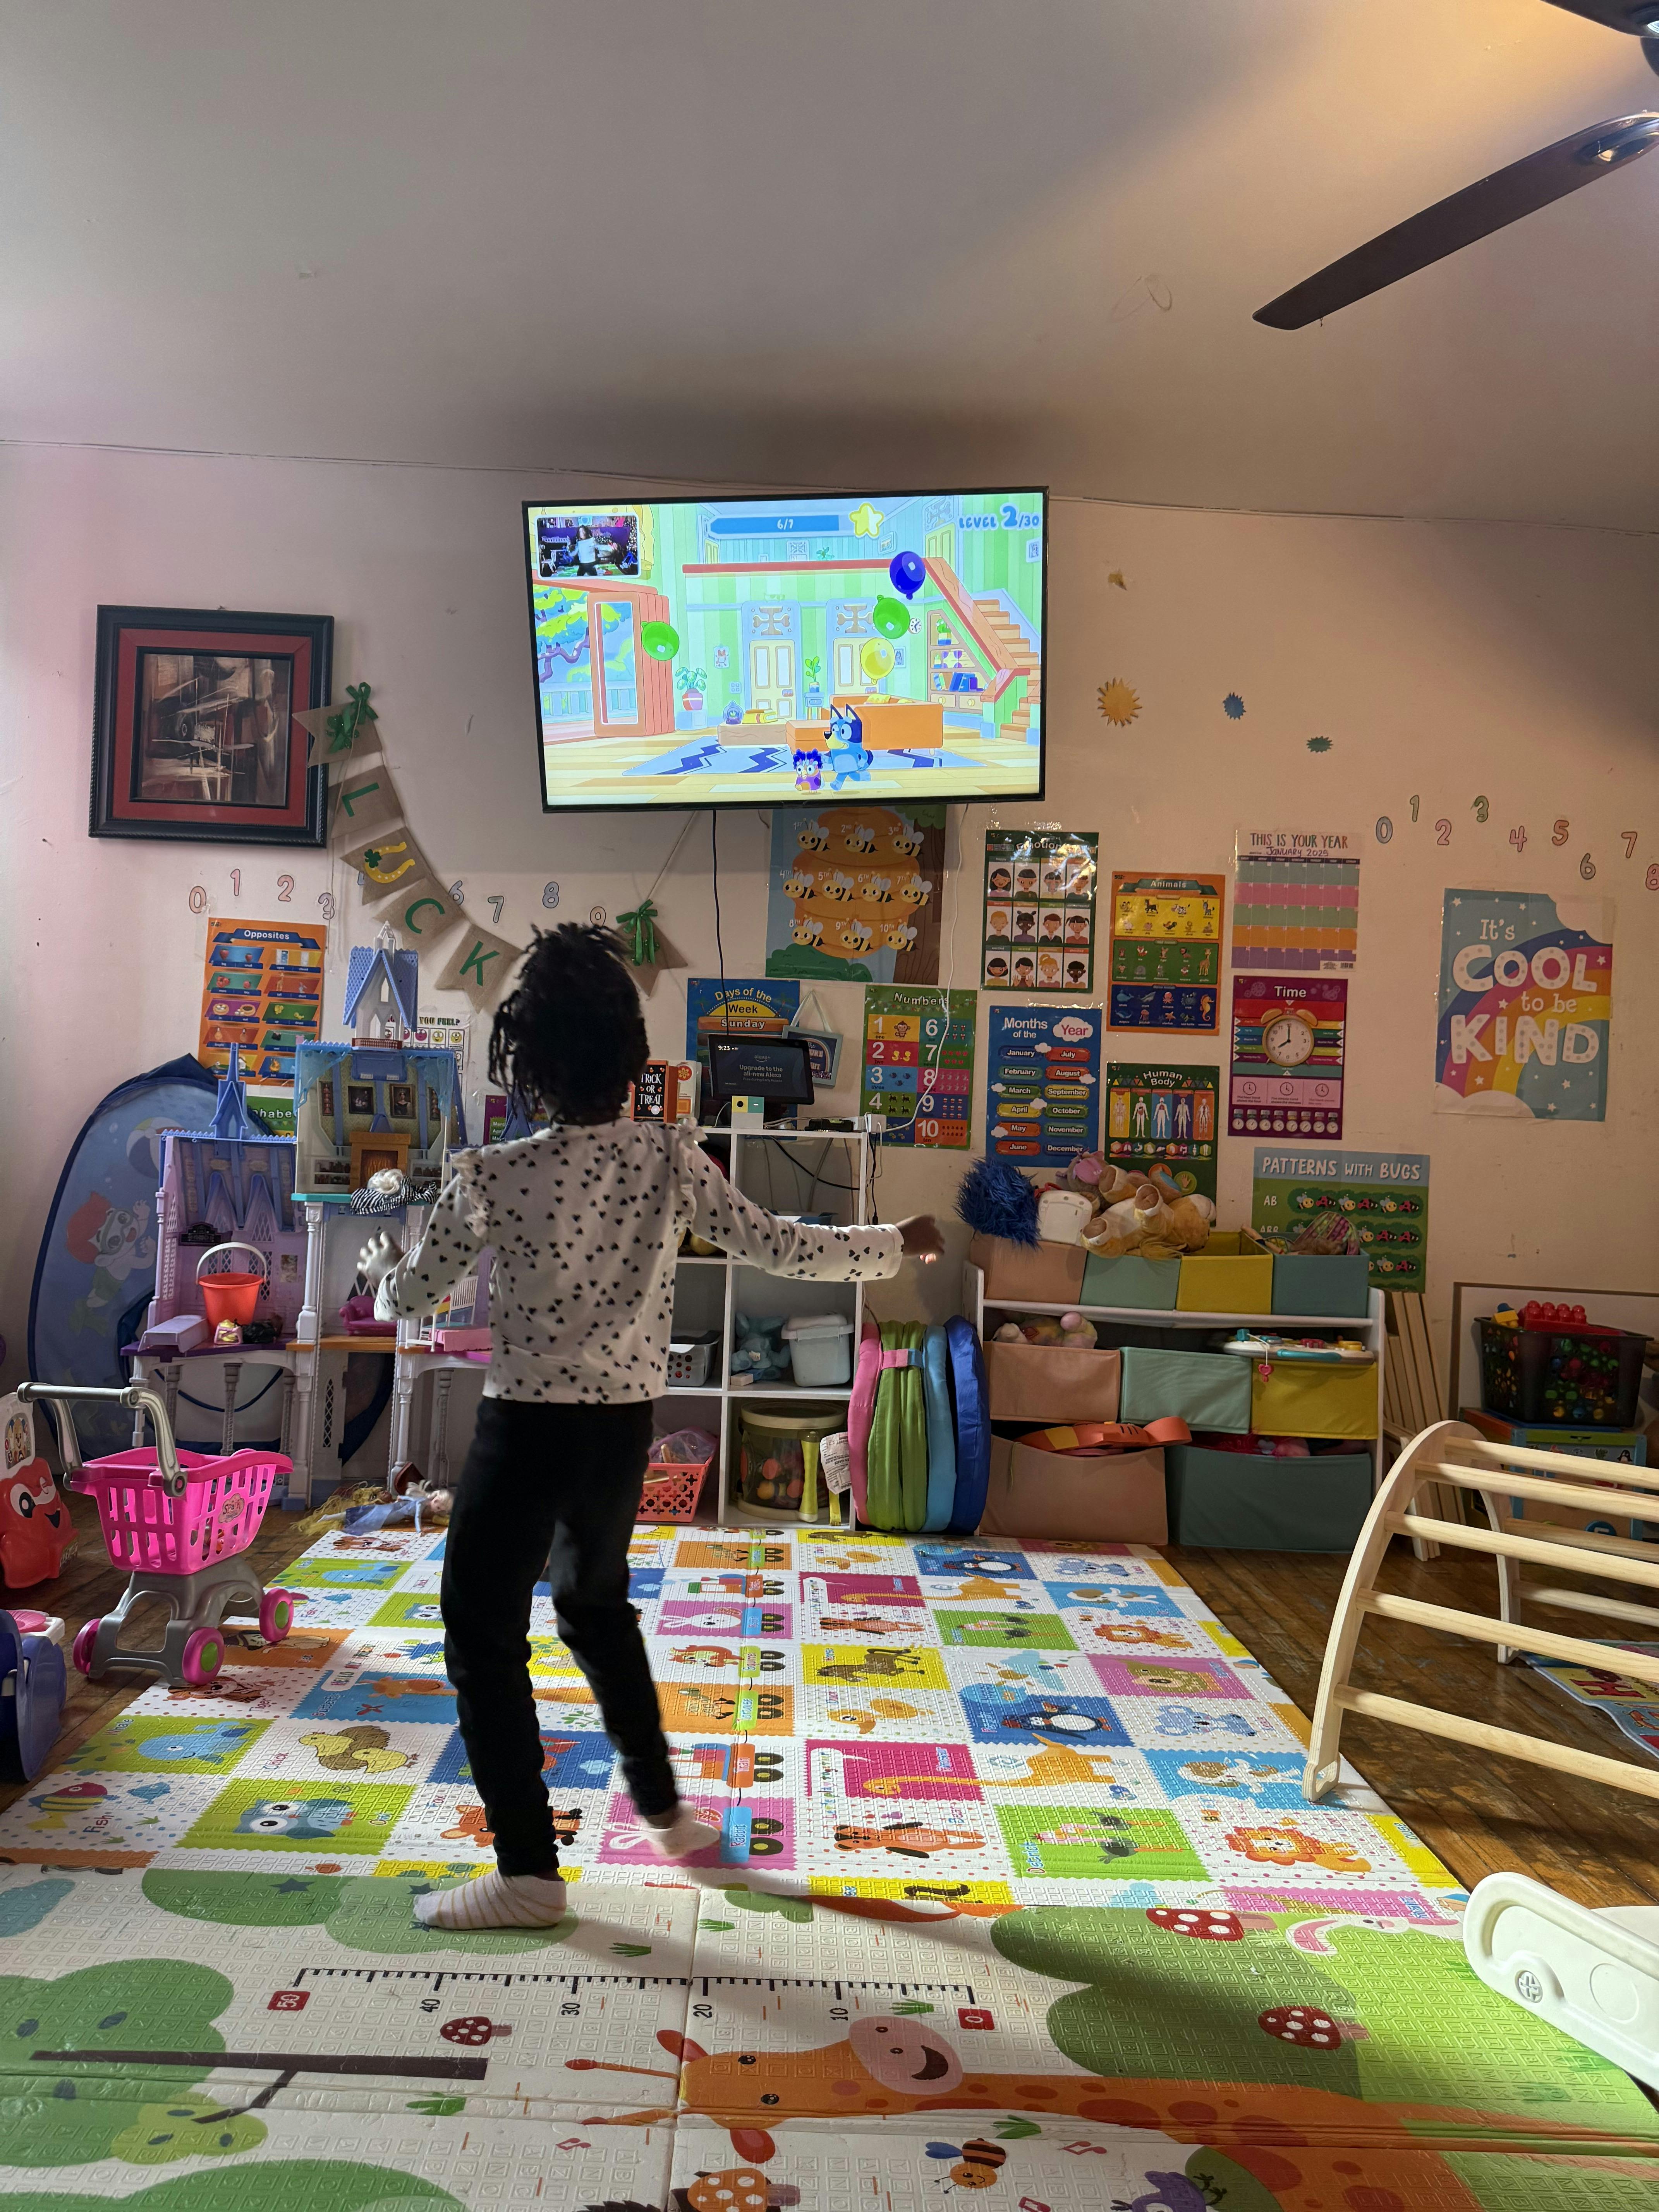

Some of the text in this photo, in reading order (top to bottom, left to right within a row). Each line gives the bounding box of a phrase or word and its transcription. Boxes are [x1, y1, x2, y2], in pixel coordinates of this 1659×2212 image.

[777, 520, 793, 530] 6/7
[958, 505, 1040, 529] LEVEL 2/30
[841, 825, 852, 833] 2ND
[889, 827, 899, 835] 3RD
[1250, 833, 1348, 848] THIS IS YOUR YEAR
[1376, 795, 1659, 890] 0 1 2 3 4 5 6 7 8
[858, 874, 869, 882] 6TH
[189, 886, 206, 914] 0
[230, 869, 240, 896] 1
[277, 875, 294, 902] 2
[318, 893, 335, 919] 3
[448, 880, 464, 905] 6
[488, 895, 504, 923] 7
[542, 881, 559, 908] 8
[789, 919, 894, 932] 8TH 9TH 10TH
[1480, 919, 1515, 940] It's
[244, 930, 290, 940] Opposites
[405, 898, 445, 934] C
[459, 941, 500, 986] K
[1453, 945, 1597, 992] COOL
[715, 988, 740, 1001] Days
[756, 989, 771, 1002] the
[894, 993, 950, 1006] Numbers
[1274, 986, 1307, 998] Time
[728, 1004, 758, 1014] Week
[1522, 994, 1577, 1013] to be
[721, 1018, 765, 1029] Sunday
[874, 1017, 938, 1036] 1 6
[1005, 1018, 1048, 1029] Months
[1061, 1025, 1088, 1036] Year
[1451, 1014, 1599, 1066] KIND
[872, 1042, 937, 1061] 2 7
[871, 1067, 935, 1087] 3 8
[1143, 1071, 1183, 1080] Human
[1151, 1078, 1175, 1087] Body
[646, 1085, 655, 1093] OR
[639, 1094, 663, 1104] TREAT
[869, 1092, 934, 1112] 4 9
[917, 1120, 939, 1137] 10
[1262, 1156, 1420, 1180] PATTERNS WITH BUGS
[1264, 1195, 1277, 1206] AB
[249, 1699, 271, 1712] Tiger
[737, 1698, 754, 1722] Tortoise
[102, 1719, 134, 1736] Whale
[264, 1752, 289, 1770] Chick
[426, 1794, 447, 1807] Fox
[82, 1814, 114, 1833] Fish
[729, 1822, 745, 1849] Rabbit
[1024, 1841, 1046, 1874] Ostrich
[276, 1994, 301, 2008] 50
[419, 1999, 441, 2013] 40
[560, 2002, 580, 2016] 30
[692, 2003, 713, 2018] 20
[830, 2008, 848, 2021] 10
